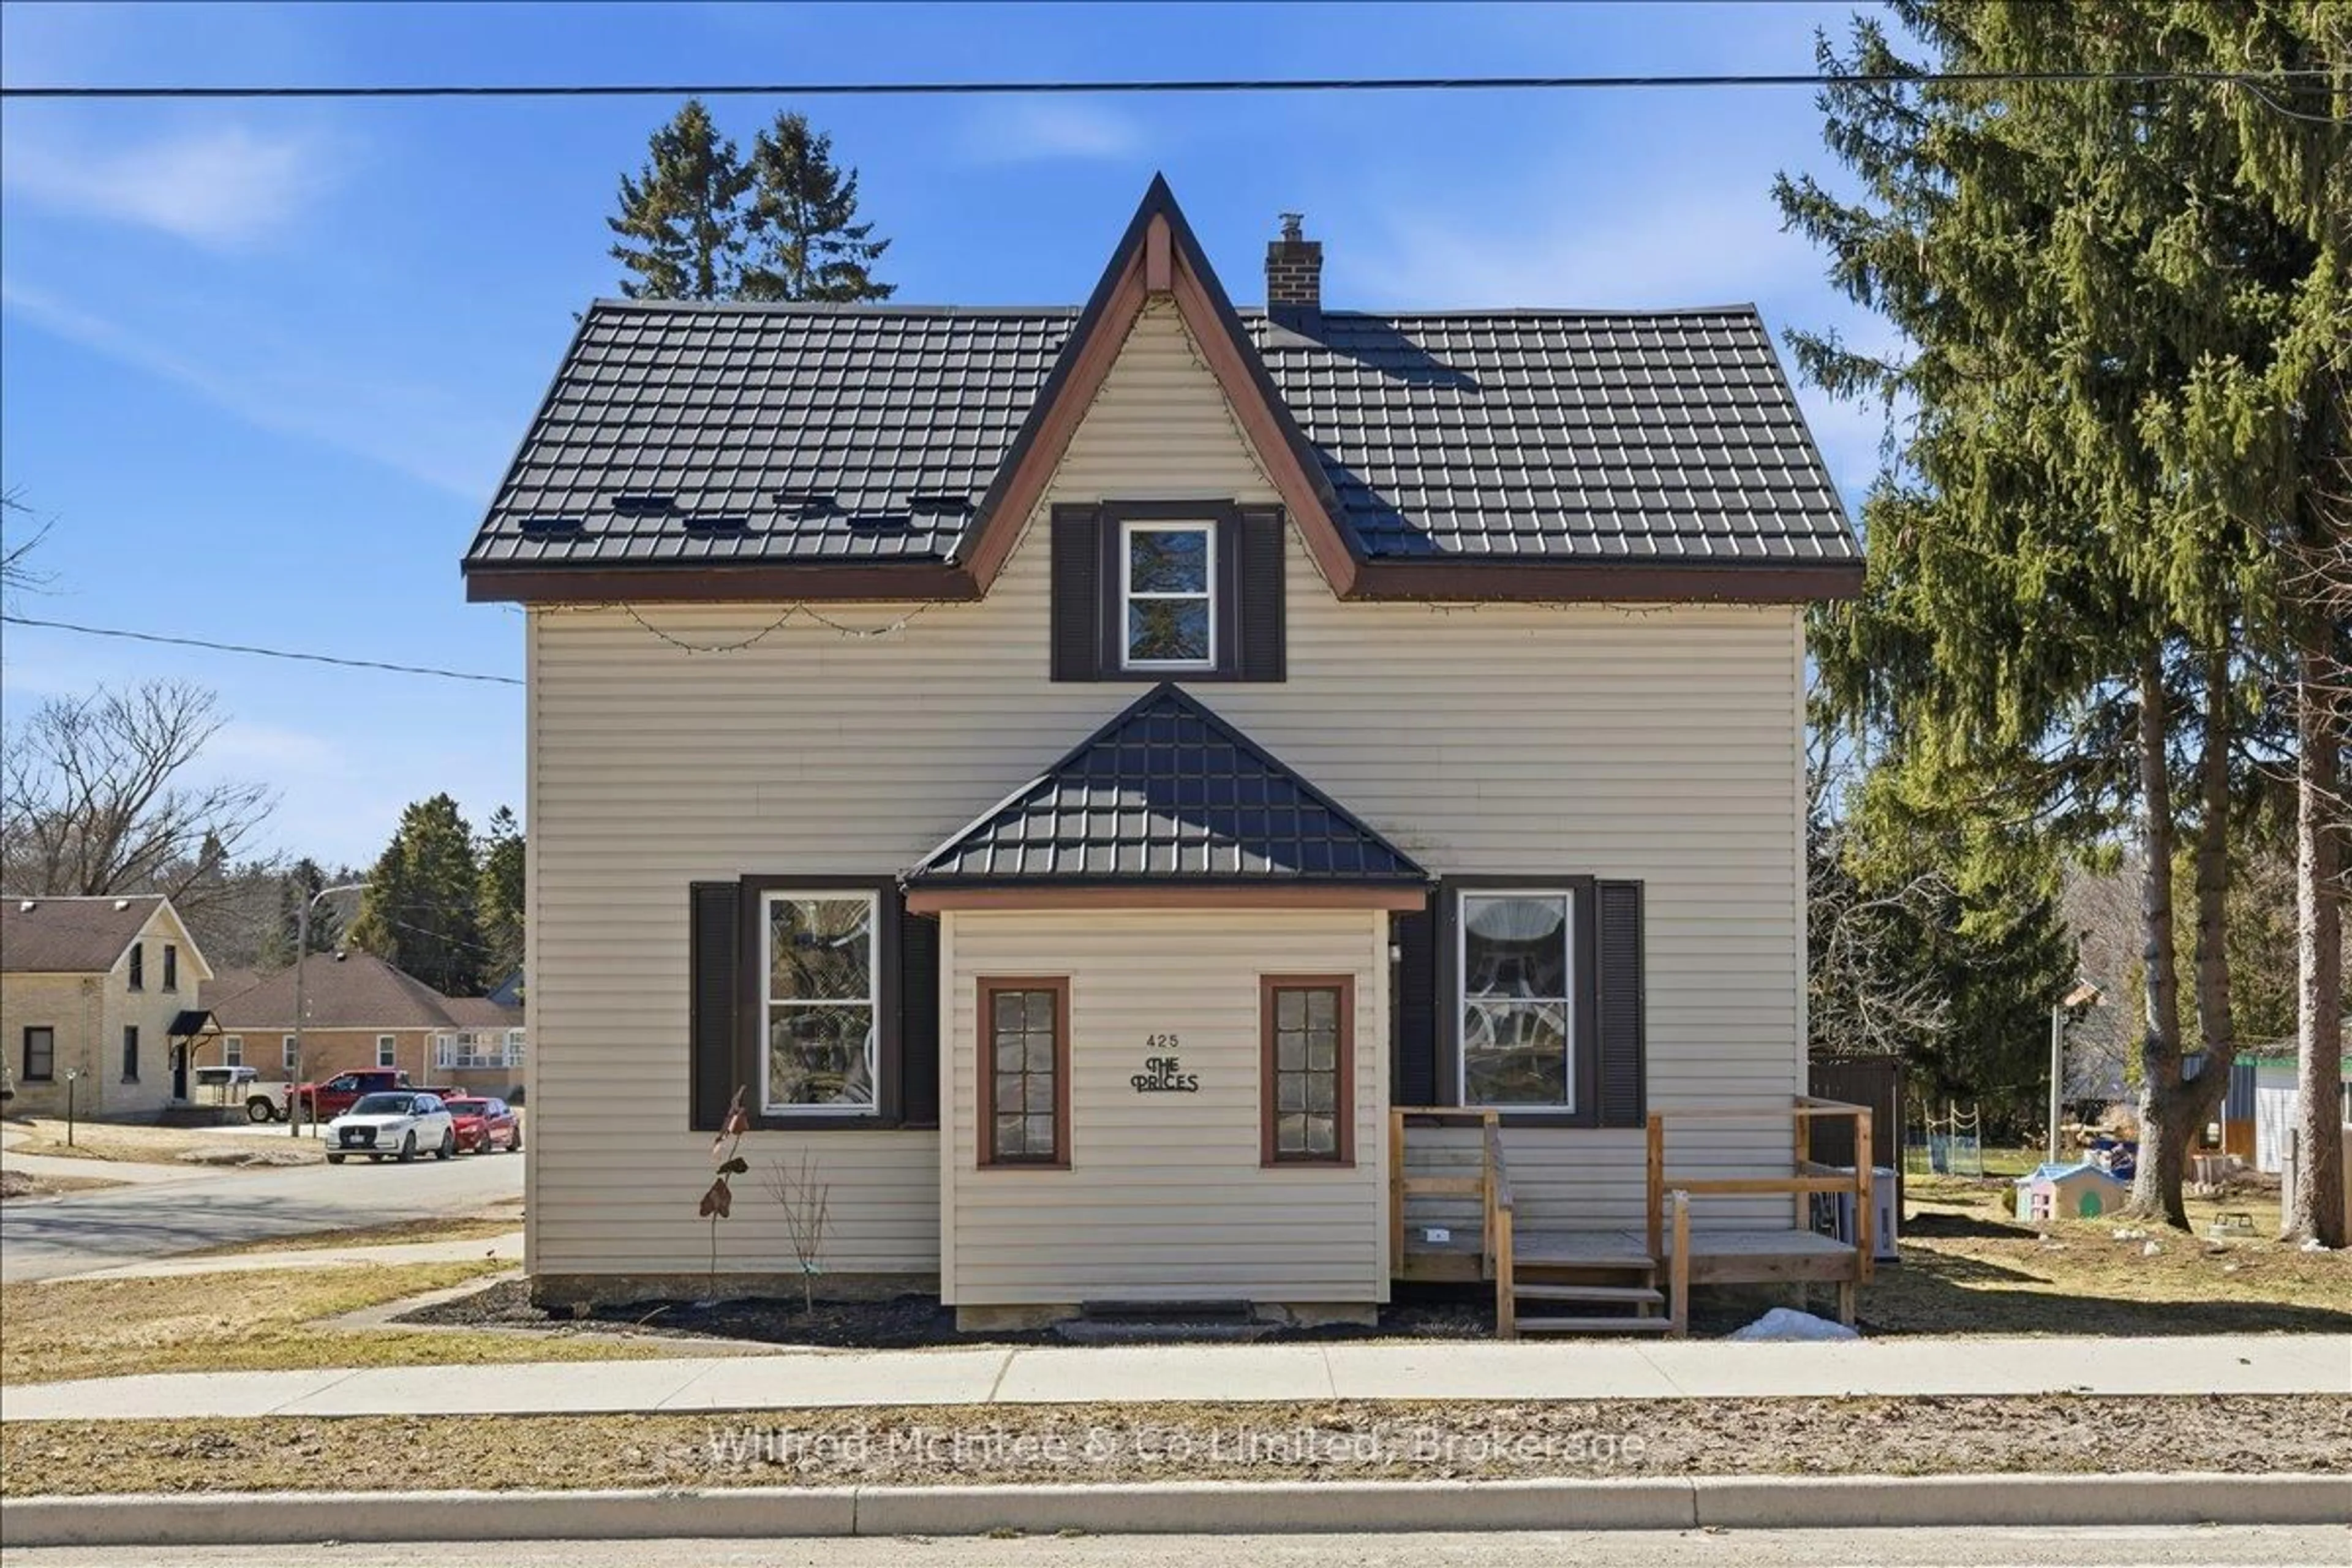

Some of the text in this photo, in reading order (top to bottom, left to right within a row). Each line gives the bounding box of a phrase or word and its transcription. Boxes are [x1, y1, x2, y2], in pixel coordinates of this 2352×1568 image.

[1146, 1035, 1179, 1048] 425
[1145, 1057, 1180, 1074] THE
[1130, 1075, 1199, 1093] PRICES
